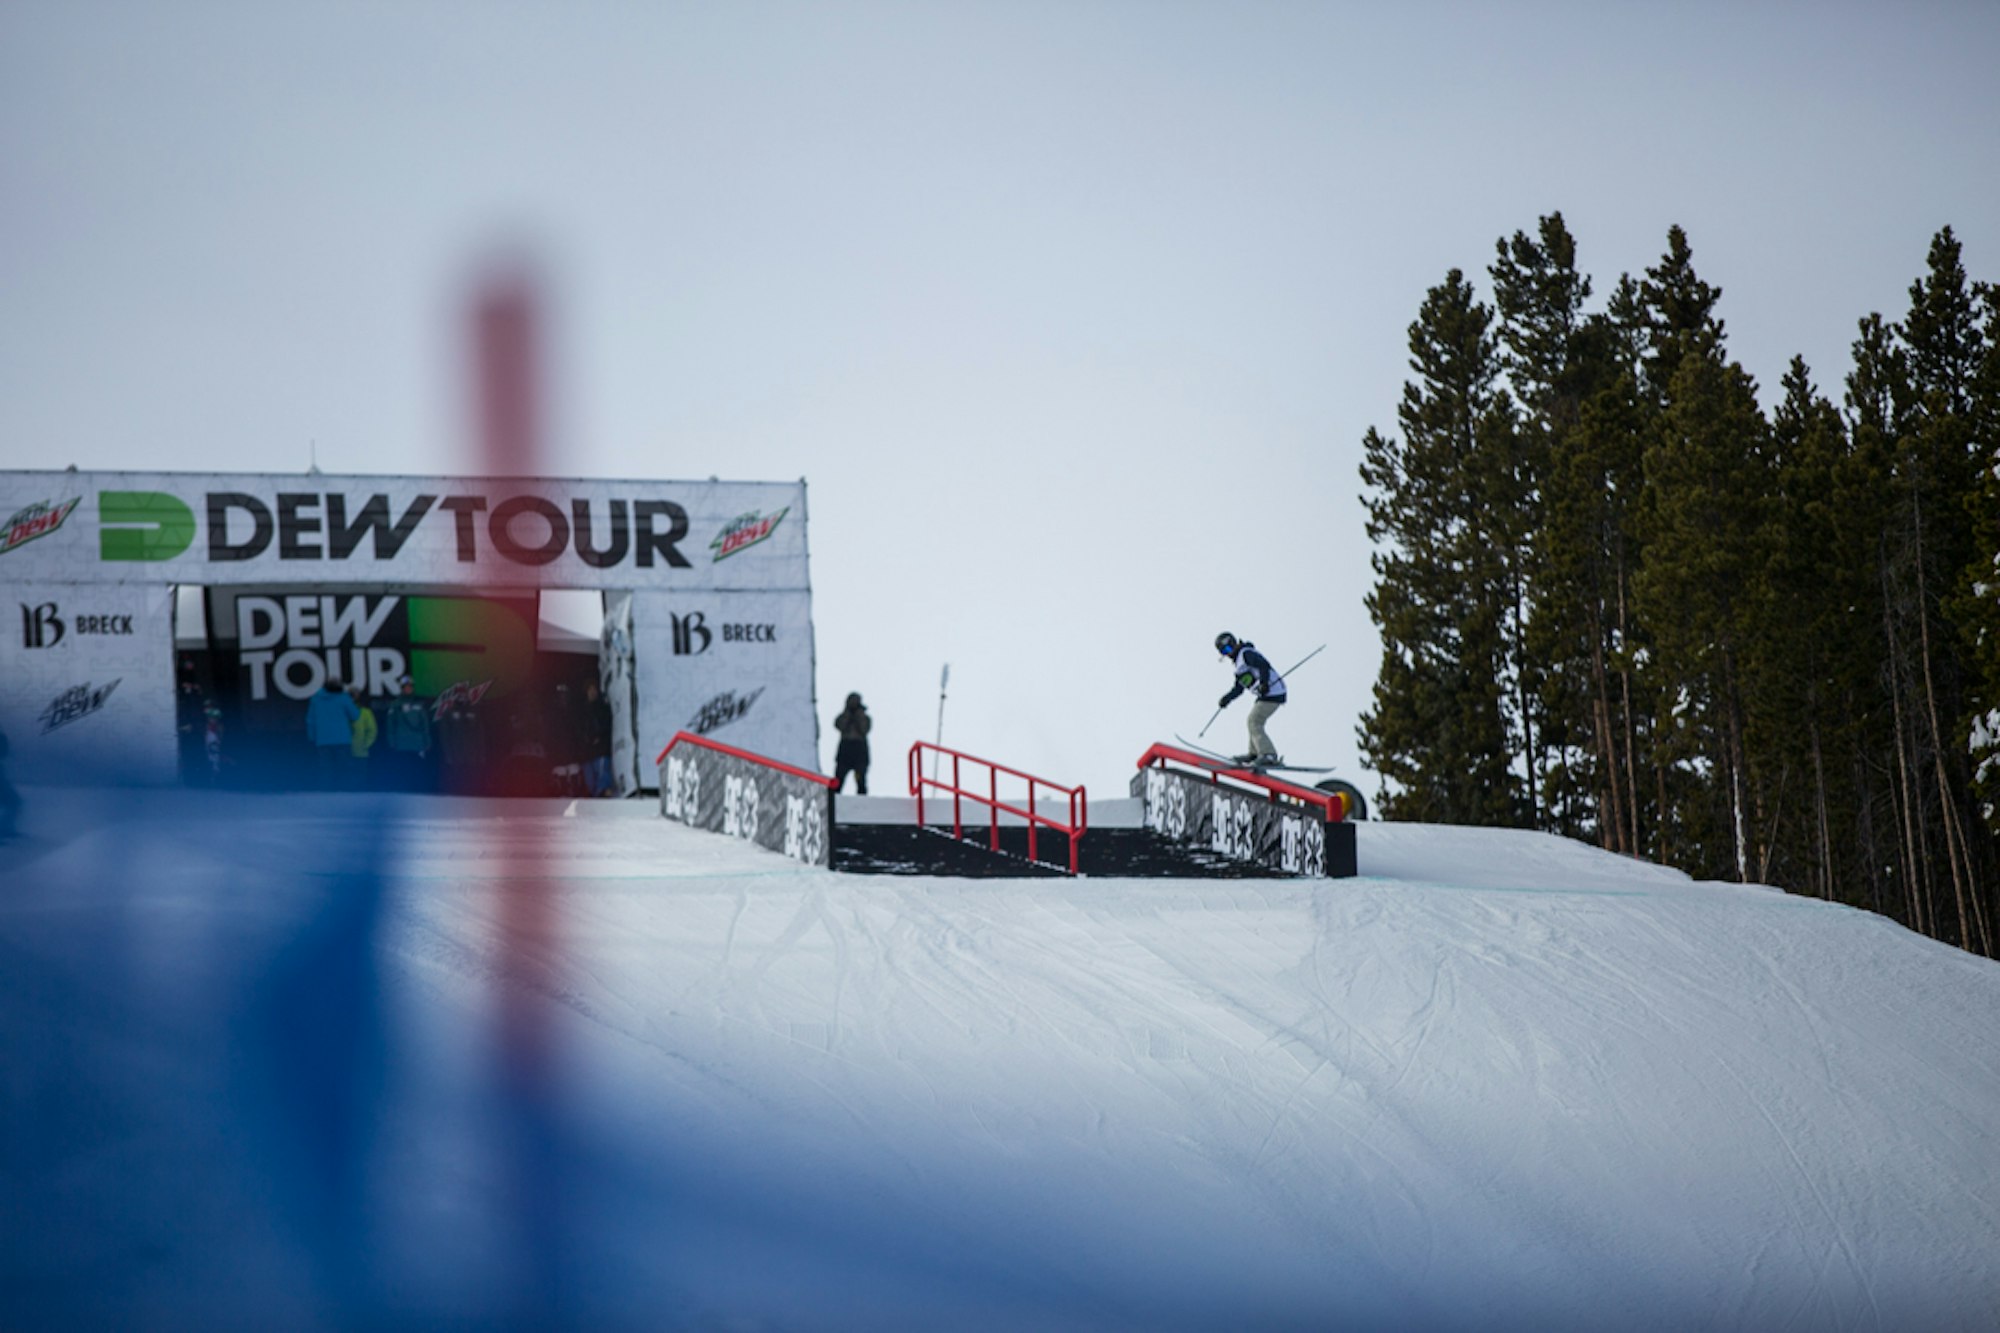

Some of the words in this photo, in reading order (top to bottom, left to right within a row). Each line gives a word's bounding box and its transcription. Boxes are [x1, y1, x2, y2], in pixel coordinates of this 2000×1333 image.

[206, 492, 438, 562] DEW
[437, 495, 693, 568] TOUR
[76, 614, 133, 635] BRECK
[237, 595, 399, 649] DEW
[723, 623, 776, 643] BRECK
[240, 648, 406, 700] TOUR
